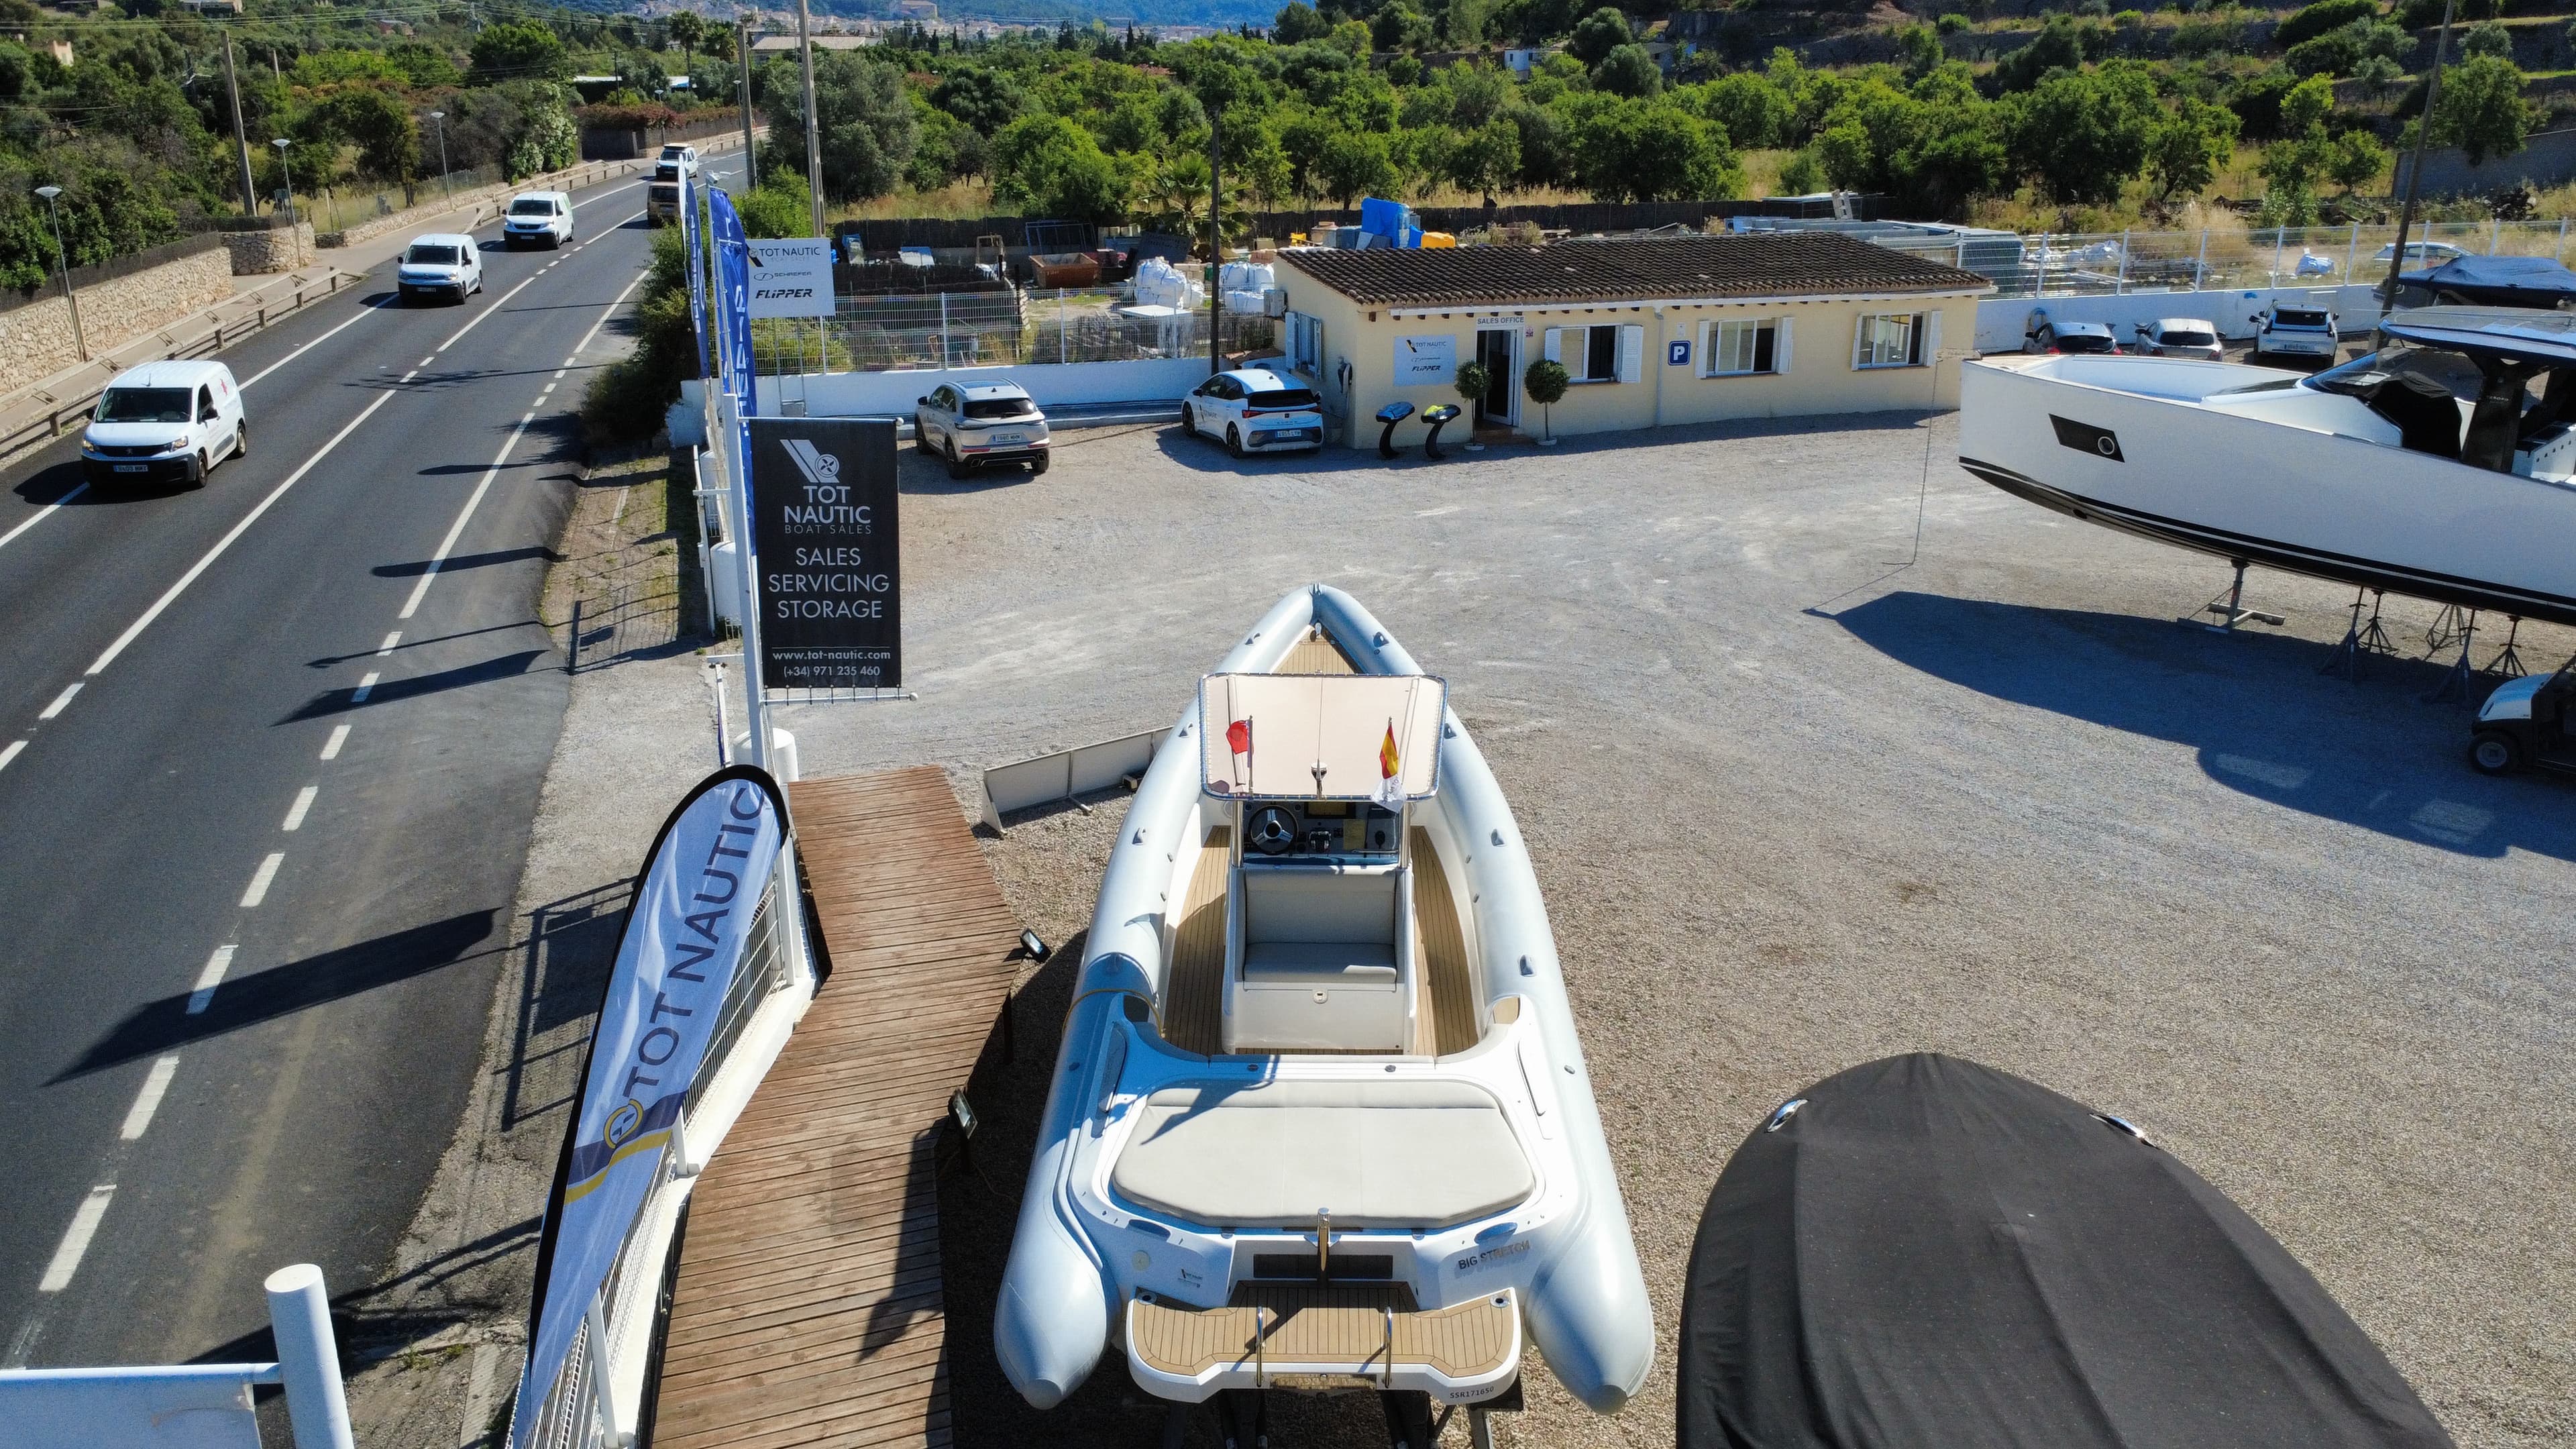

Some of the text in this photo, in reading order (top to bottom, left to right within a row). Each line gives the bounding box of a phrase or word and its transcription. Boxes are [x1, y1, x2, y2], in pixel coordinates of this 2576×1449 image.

[759, 247, 820, 257] TOT NAUTIC
[1674, 346, 1686, 361] P
[803, 486, 851, 503] TOT
[784, 506, 871, 524] NAUTIC
[785, 525, 871, 534] BOAT SALES
[796, 547, 861, 566] SALES
[769, 574, 890, 592] SERVICING
[777, 600, 882, 619] STORAGE
[773, 649, 891, 660] www.tot-nautic.com
[784, 665, 880, 678] (+34) 971 235 460
[623, 787, 766, 1098] TOT NAUTIC
[1458, 1256, 1478, 1270] BIG
[1450, 1386, 1495, 1399] SSR171650
